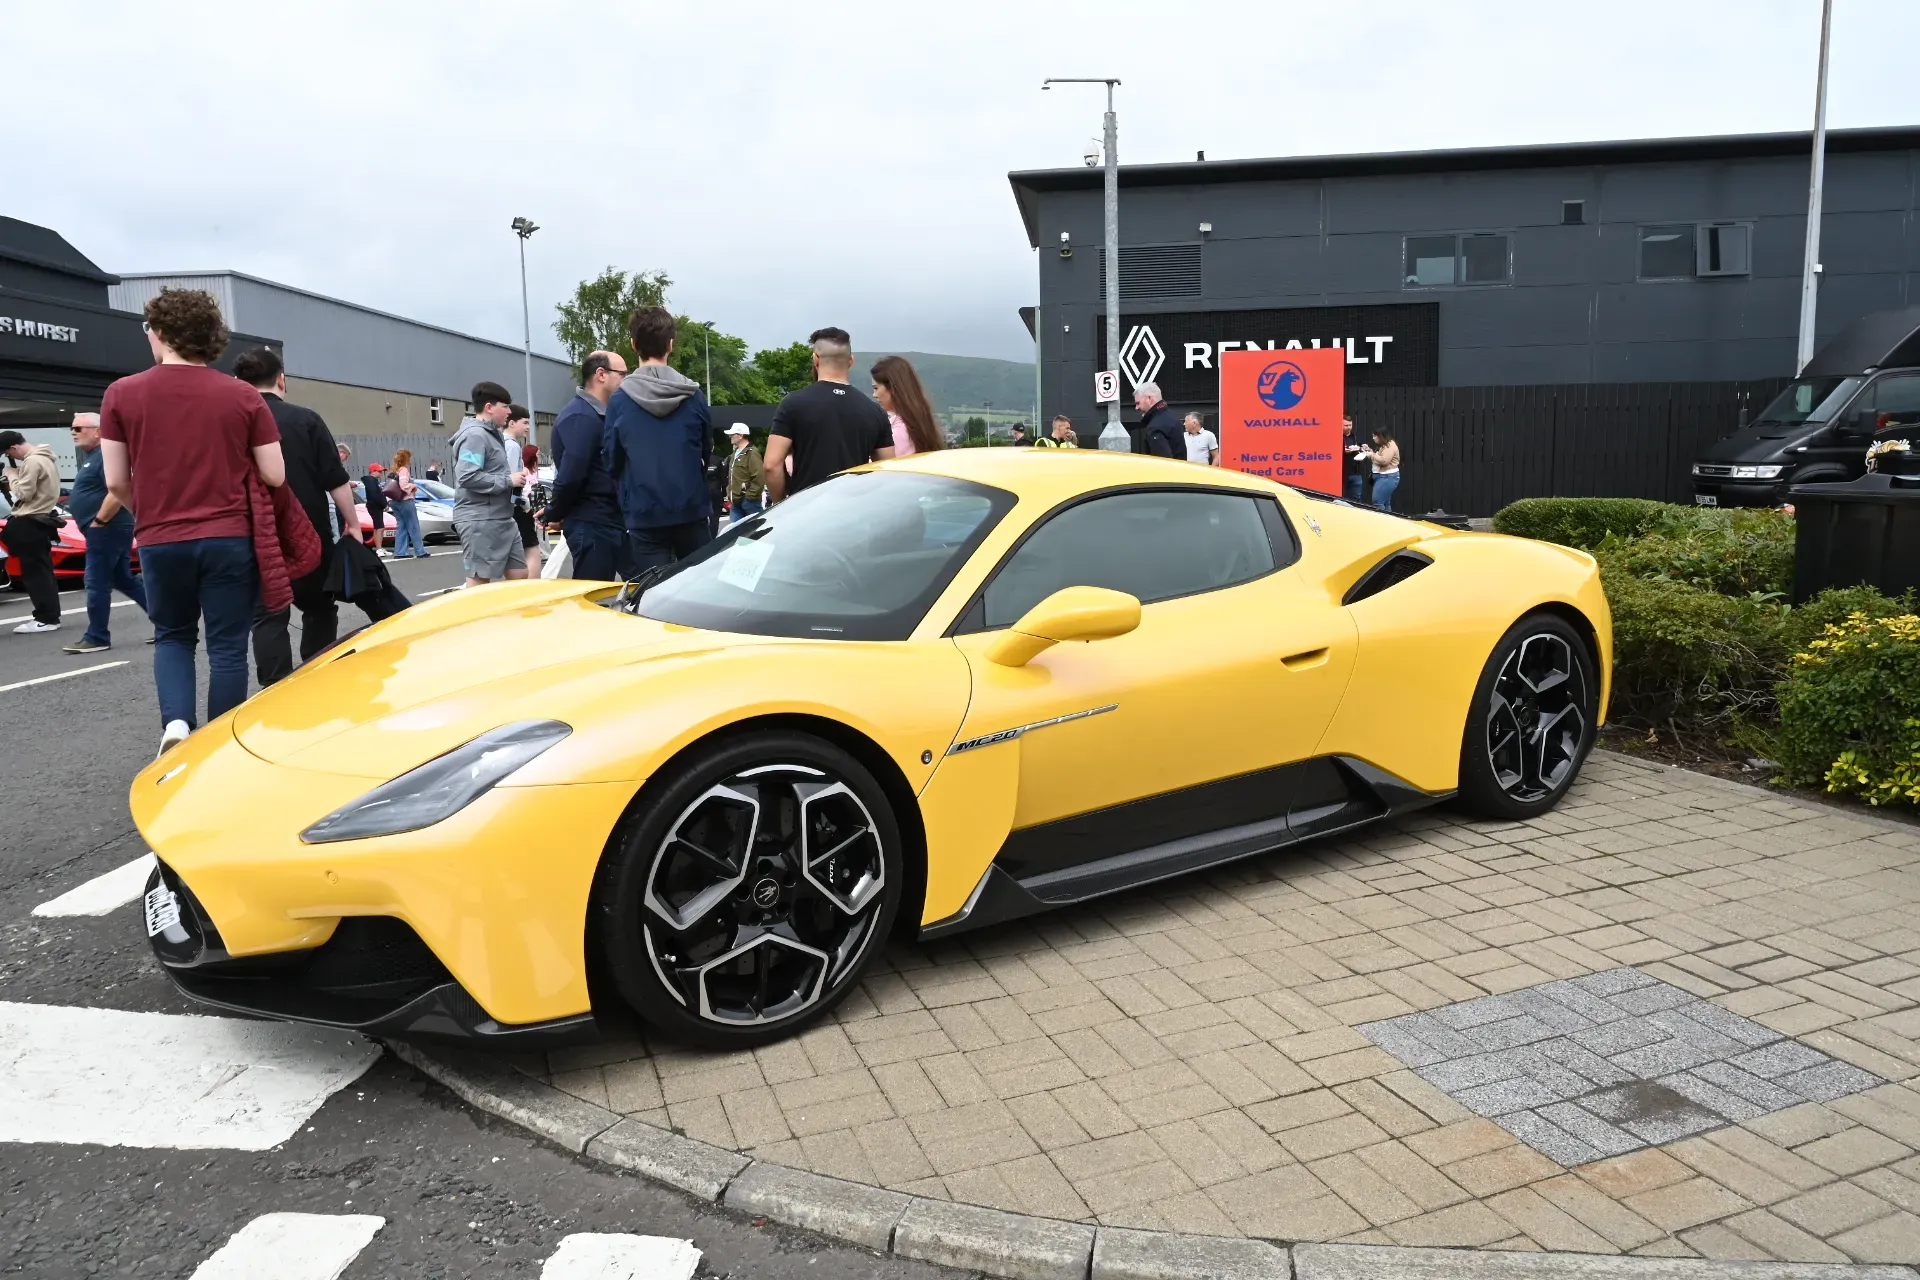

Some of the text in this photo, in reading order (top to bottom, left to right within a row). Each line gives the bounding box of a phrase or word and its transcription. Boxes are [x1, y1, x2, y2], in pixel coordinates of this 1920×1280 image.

[15, 318, 80, 343] HURST
[1103, 376, 1111, 391] 5
[1243, 418, 1321, 428] VAUXHALL
[1241, 452, 1332, 462] New Car Sales
[1276, 467, 1304, 476] Cars
[956, 729, 1018, 752] MC20
